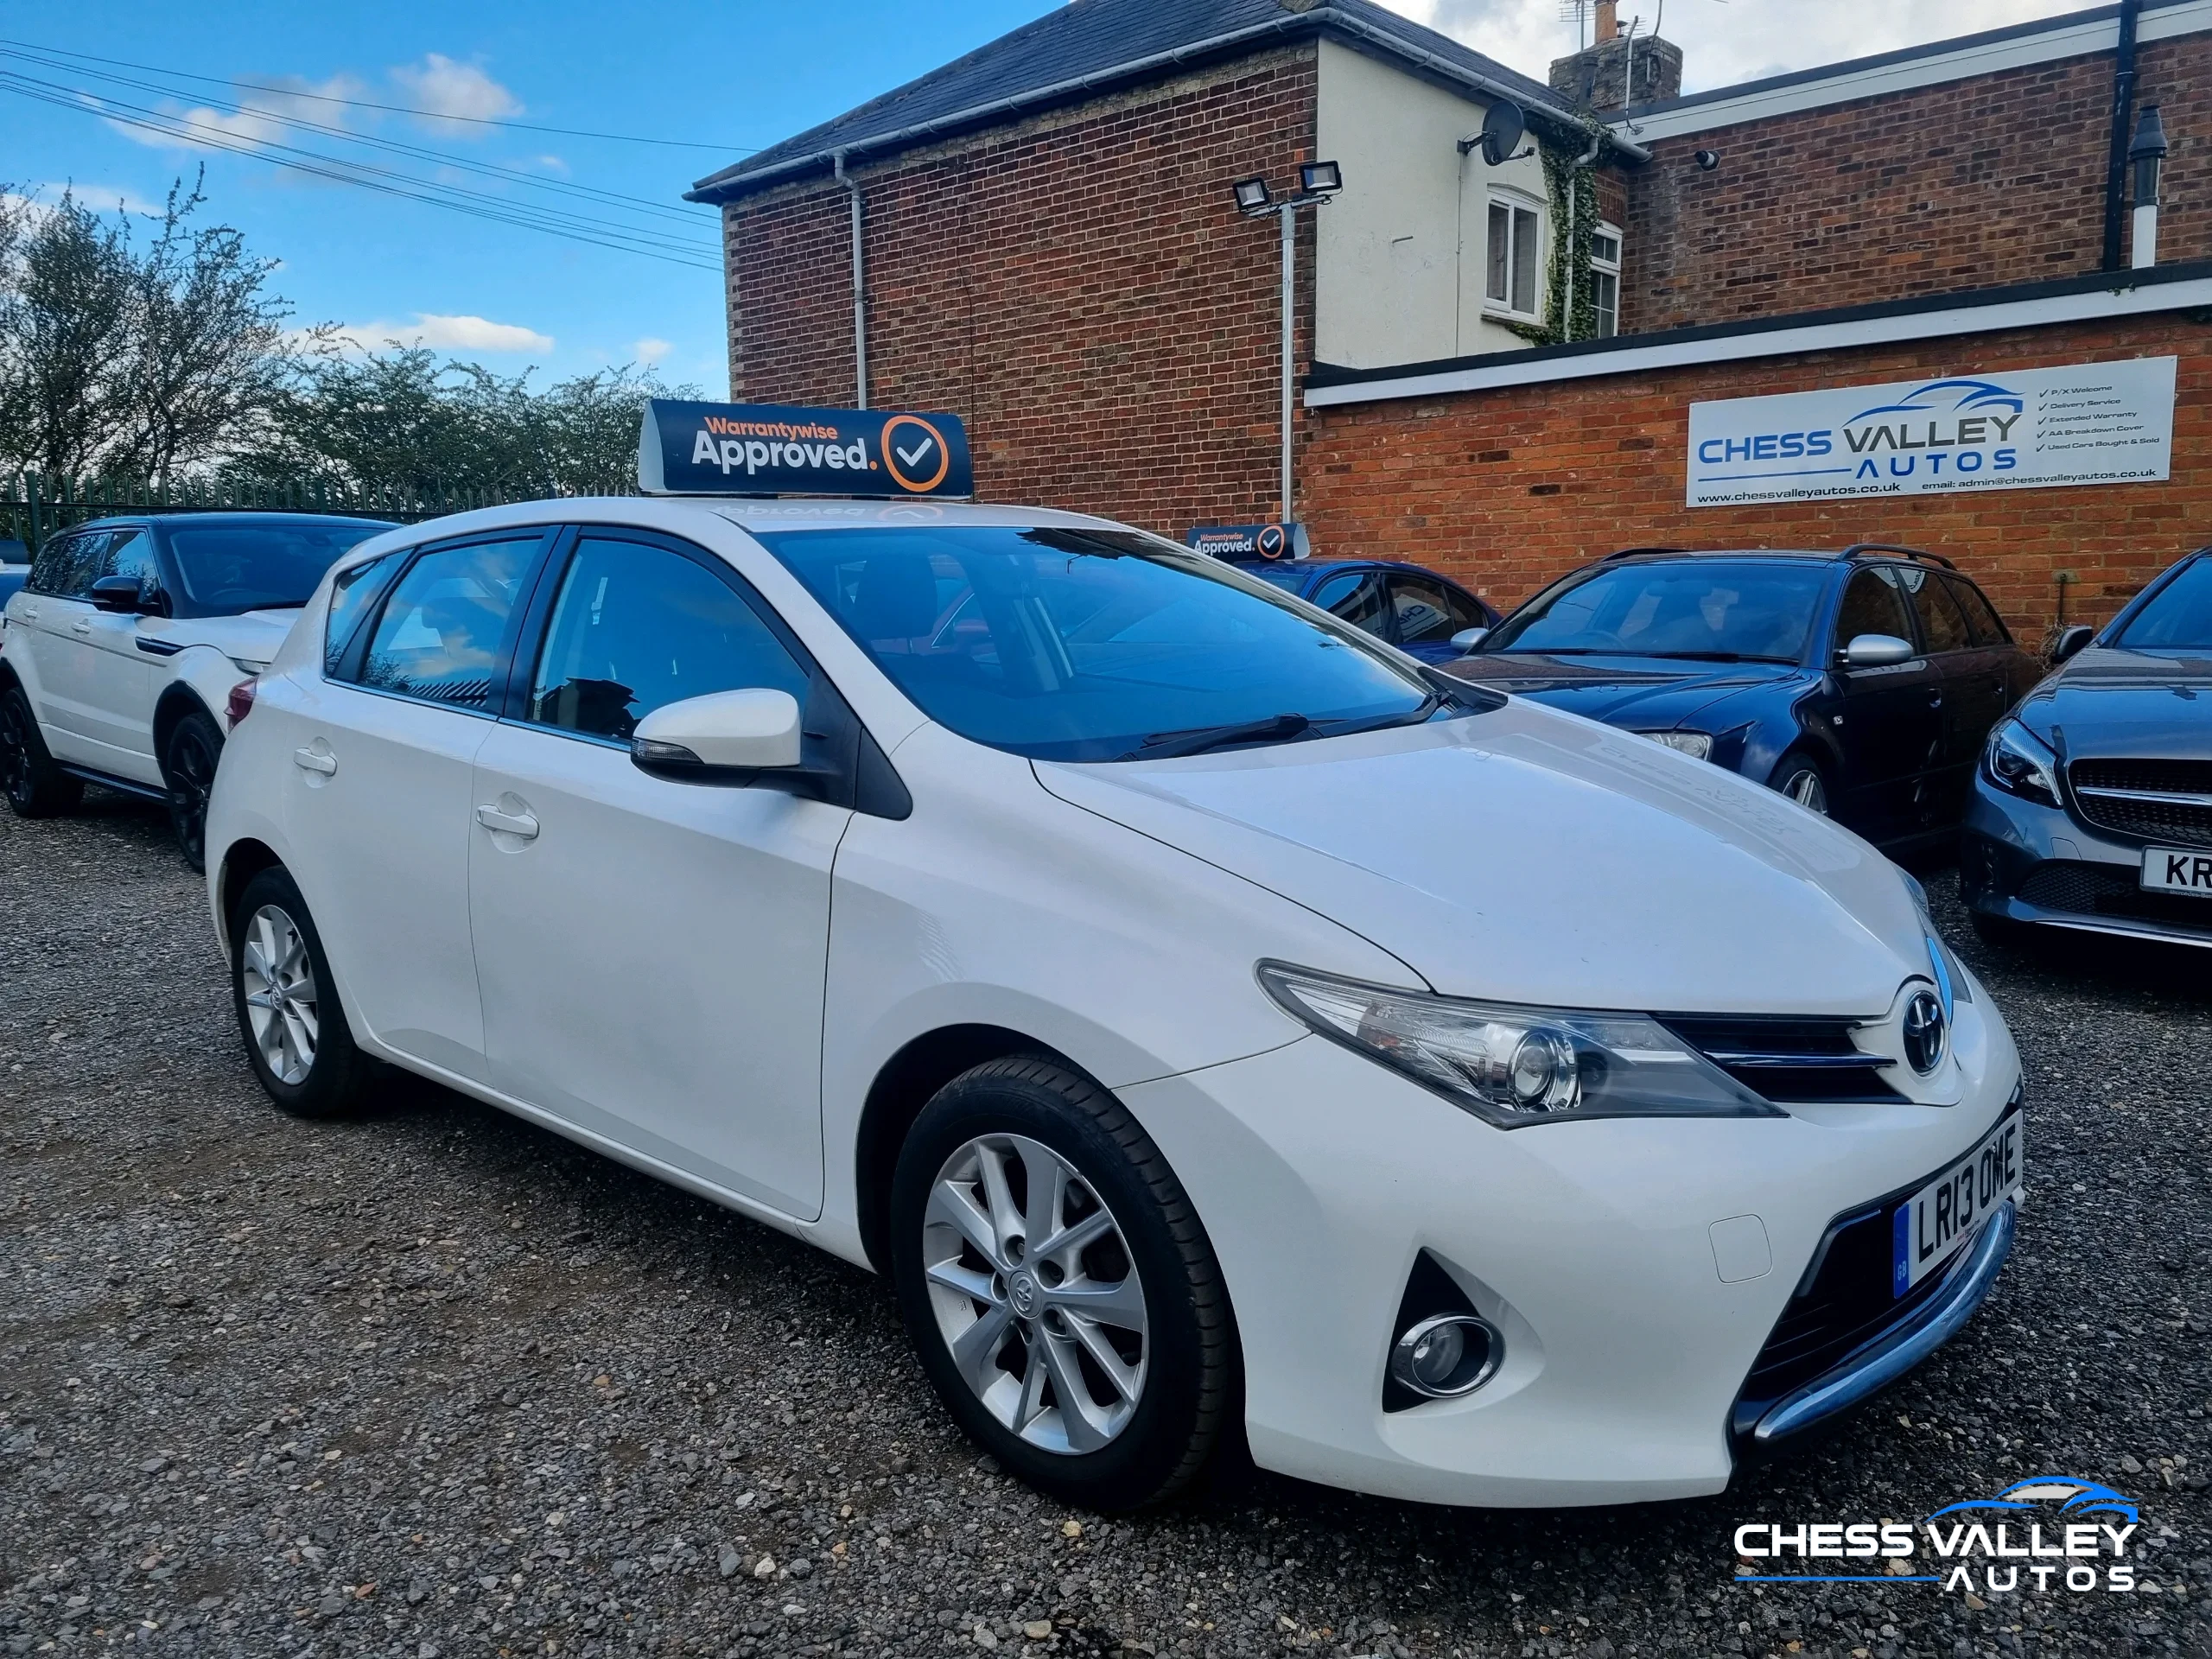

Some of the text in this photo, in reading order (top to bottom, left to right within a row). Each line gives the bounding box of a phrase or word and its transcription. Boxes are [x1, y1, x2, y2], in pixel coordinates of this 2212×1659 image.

[2071, 385, 2113, 394] Welcome
[2050, 401, 2086, 410] Delivery
[2049, 411, 2138, 423] Extended Warranty
[704, 416, 838, 442] Warrantywise
[1699, 414, 2023, 464] CHESS VALLEY
[2064, 427, 2115, 435] Breakdown
[691, 430, 878, 475] Approved.
[2095, 439, 2129, 448] Bought
[1855, 448, 2016, 479] AUTOS
[1922, 468, 2157, 490] email: admin@chessvalleyautos.co.uk
[1698, 482, 1901, 503] www.chessvalleyautos.co.uk
[1200, 532, 1243, 542] Warrantywise
[1918, 1122, 2016, 1264] LR13 OME
[1897, 1260, 1907, 1281] GB
